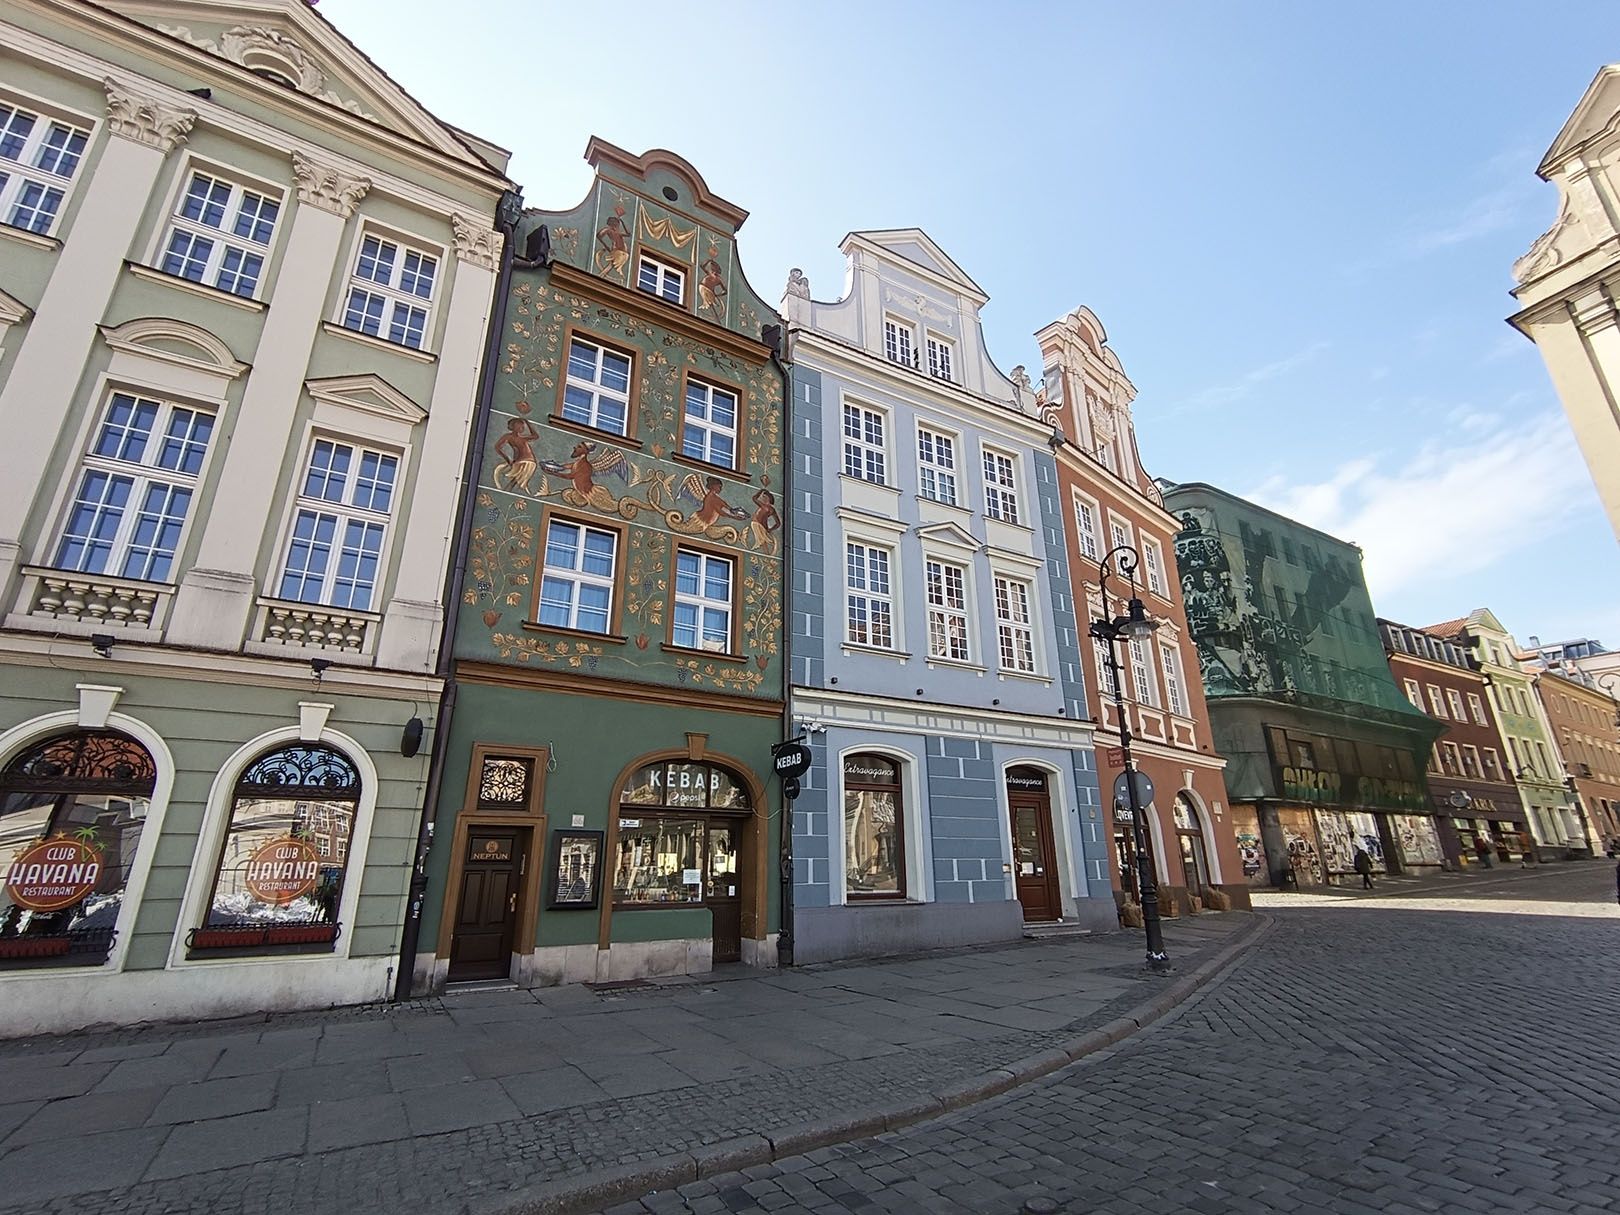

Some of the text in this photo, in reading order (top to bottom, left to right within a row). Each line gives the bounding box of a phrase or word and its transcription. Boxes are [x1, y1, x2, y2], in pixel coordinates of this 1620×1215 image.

[776, 752, 802, 770] KEBAB
[844, 761, 895, 779] Extravagance
[650, 770, 720, 790] KEBAB
[1005, 773, 1043, 788] xtravagance
[46, 847, 76, 861] CLUB
[275, 847, 299, 859] CLUB
[473, 852, 509, 860] NEPTUN
[8, 862, 100, 886] HAVANA
[246, 861, 319, 881] HAVANA
[22, 886, 76, 897] RESTAURANT
[258, 881, 301, 891] RESTAURANT
